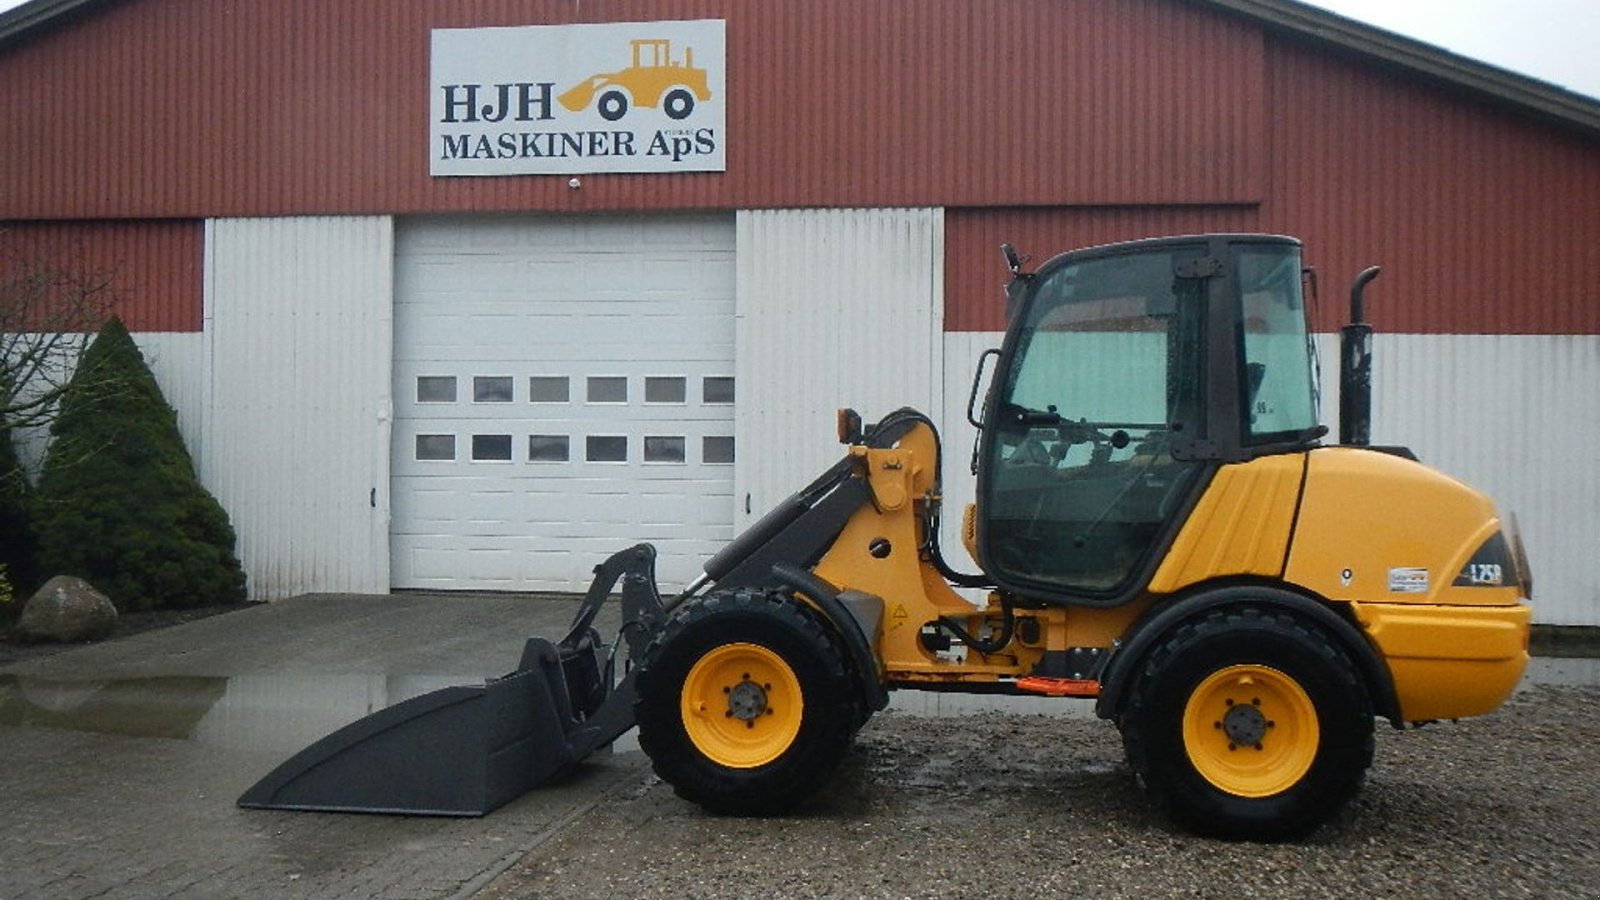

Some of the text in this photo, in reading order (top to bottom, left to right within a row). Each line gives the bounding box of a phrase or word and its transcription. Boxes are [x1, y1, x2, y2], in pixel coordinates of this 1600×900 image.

[440, 83, 555, 122] HJH
[440, 128, 716, 162] MASKINER ApS
